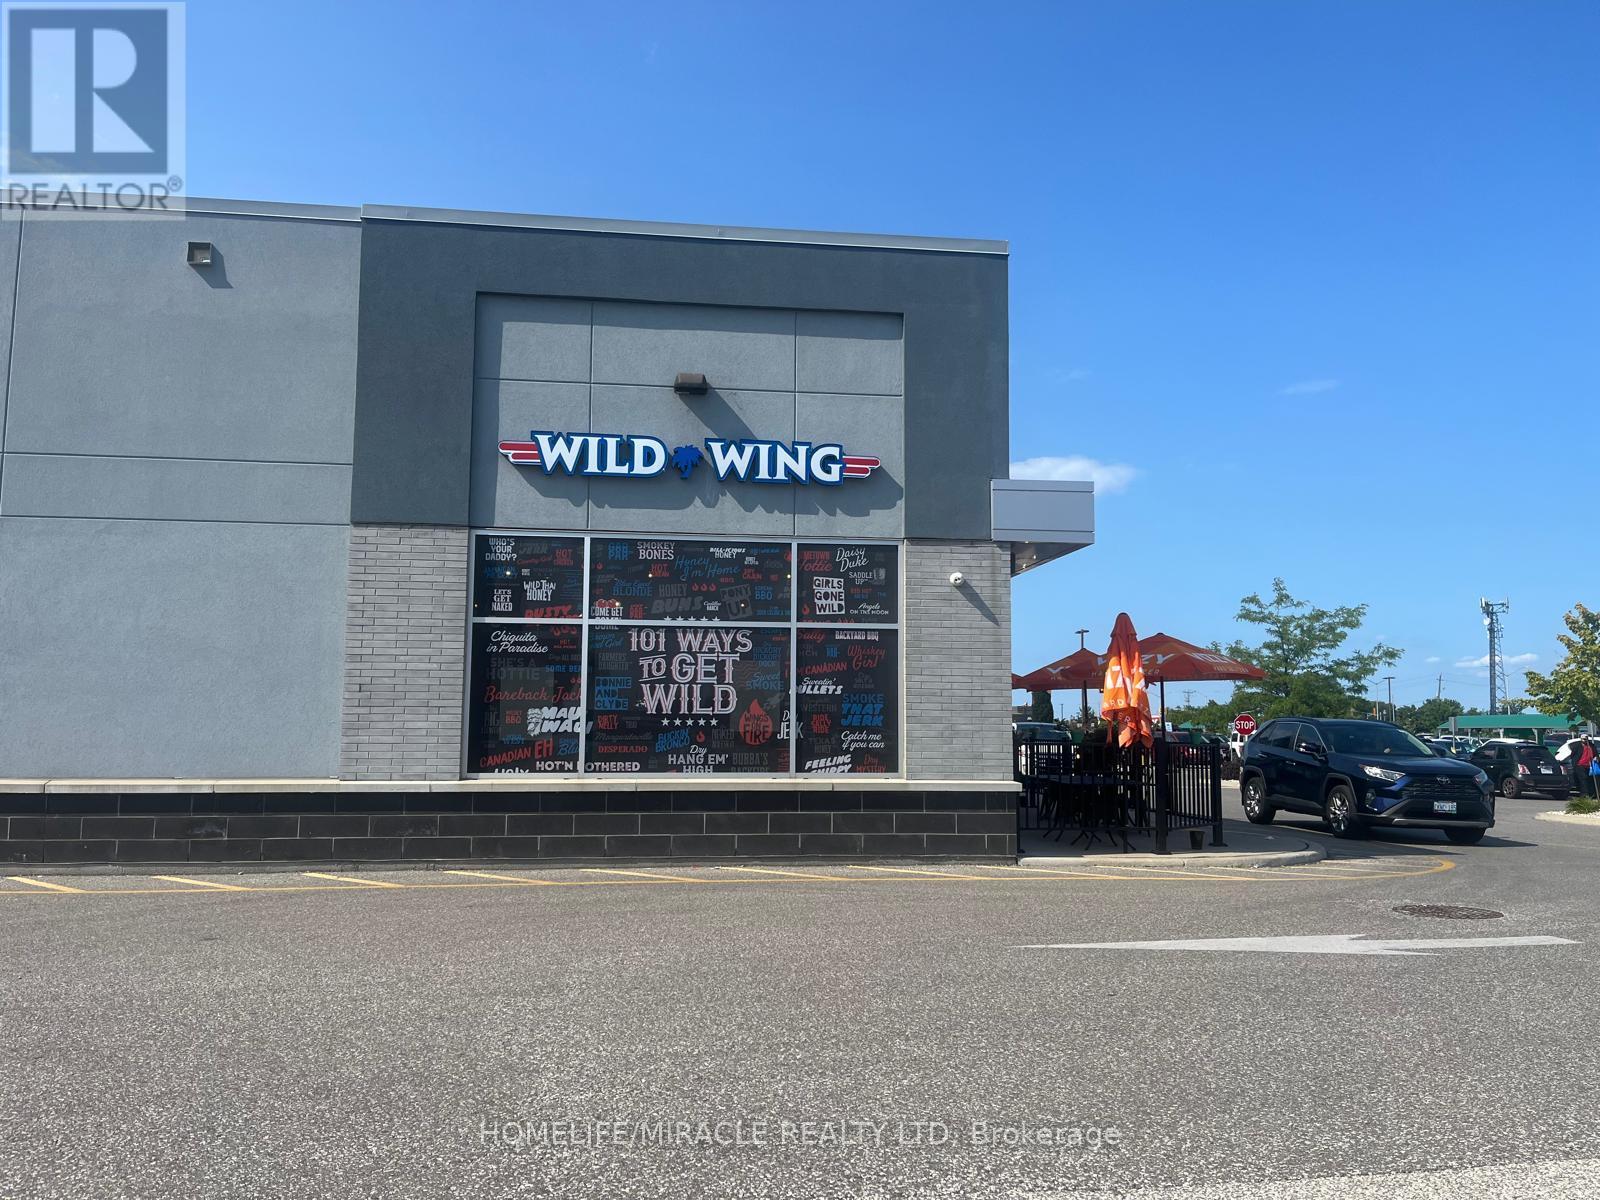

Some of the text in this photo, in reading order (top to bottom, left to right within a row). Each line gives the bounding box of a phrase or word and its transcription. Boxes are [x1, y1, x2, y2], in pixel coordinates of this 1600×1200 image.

[531, 430, 845, 485] WILD WING
[488, 538, 515, 546] WHO'S
[637, 541, 675, 549] SMOKEY
[491, 545, 512, 554] YOUR
[638, 549, 674, 560] BONES
[835, 546, 866, 562] Daisy
[485, 553, 517, 561] DADDY?
[840, 557, 869, 572] Duke
[848, 571, 872, 579] SADDLE
[523, 579, 557, 591] WILD THAI
[814, 578, 843, 589] GIRLS
[526, 590, 552, 601] HONEY
[815, 591, 844, 601] GONE
[491, 602, 513, 612] NAKED
[590, 607, 611, 617] COME
[611, 607, 624, 617] GET
[817, 603, 845, 613] WILD
[628, 628, 666, 652] 101
[676, 629, 753, 653] WAYS
[835, 631, 866, 640] BACKYARD
[486, 644, 497, 653] in
[498, 641, 549, 654] Paradise
[489, 657, 525, 668] SHE'S
[639, 652, 740, 684] TO GET
[805, 662, 848, 676] CANADIAN
[595, 678, 631, 688] BONNIE
[746, 681, 785, 690] SMOKE
[484, 685, 549, 703] Bareback
[595, 688, 619, 698] AND
[796, 685, 843, 695] ULLETS
[640, 683, 738, 716] WILD
[842, 693, 884, 703] SMOKE
[595, 699, 628, 709] CLYDE
[841, 703, 884, 715] THAT
[840, 715, 884, 727] JERK
[1235, 720, 1255, 730] STOP
[743, 723, 769, 743] FIRE
[777, 721, 804, 740] JEK
[841, 730, 868, 741] Catch
[598, 745, 648, 753] DESPERADO
[850, 741, 868, 752] you
[869, 741, 885, 749] can
[480, 738, 554, 768] CANADIAN EH
[668, 754, 729, 765] HANG EM'
[804, 754, 852, 771] FEELING
